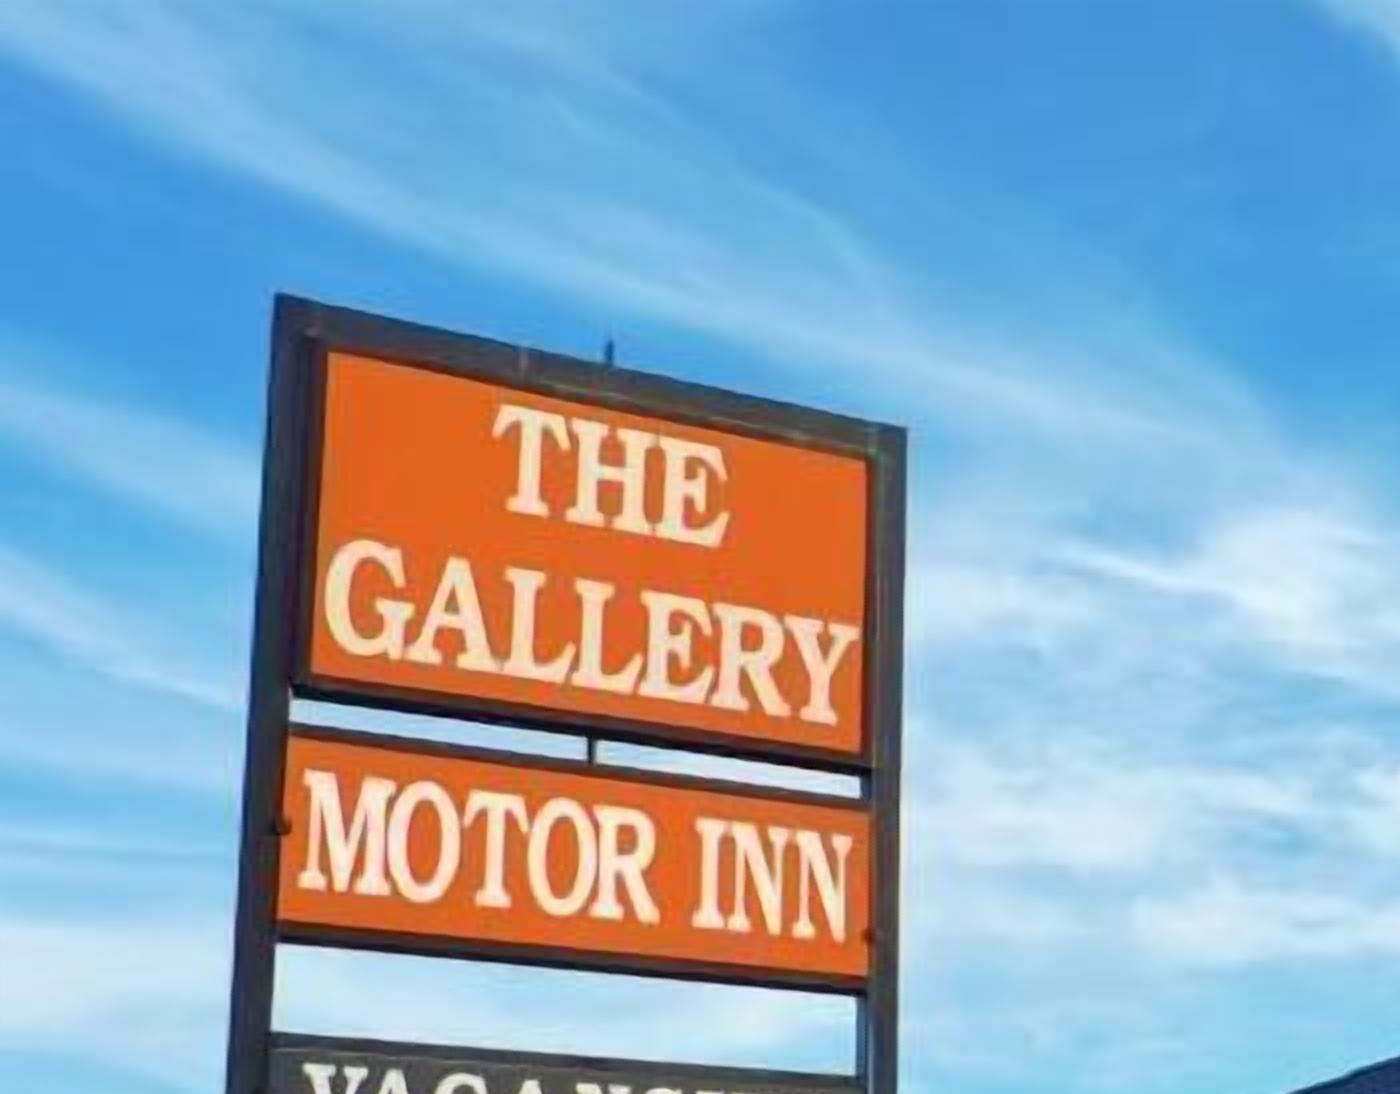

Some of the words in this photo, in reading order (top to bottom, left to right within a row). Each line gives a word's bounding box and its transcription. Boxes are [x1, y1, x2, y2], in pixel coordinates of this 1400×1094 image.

[492, 404, 730, 548] THE
[323, 539, 861, 726] GALLERY
[297, 768, 661, 925] MOTOR
[692, 817, 853, 943] INN
